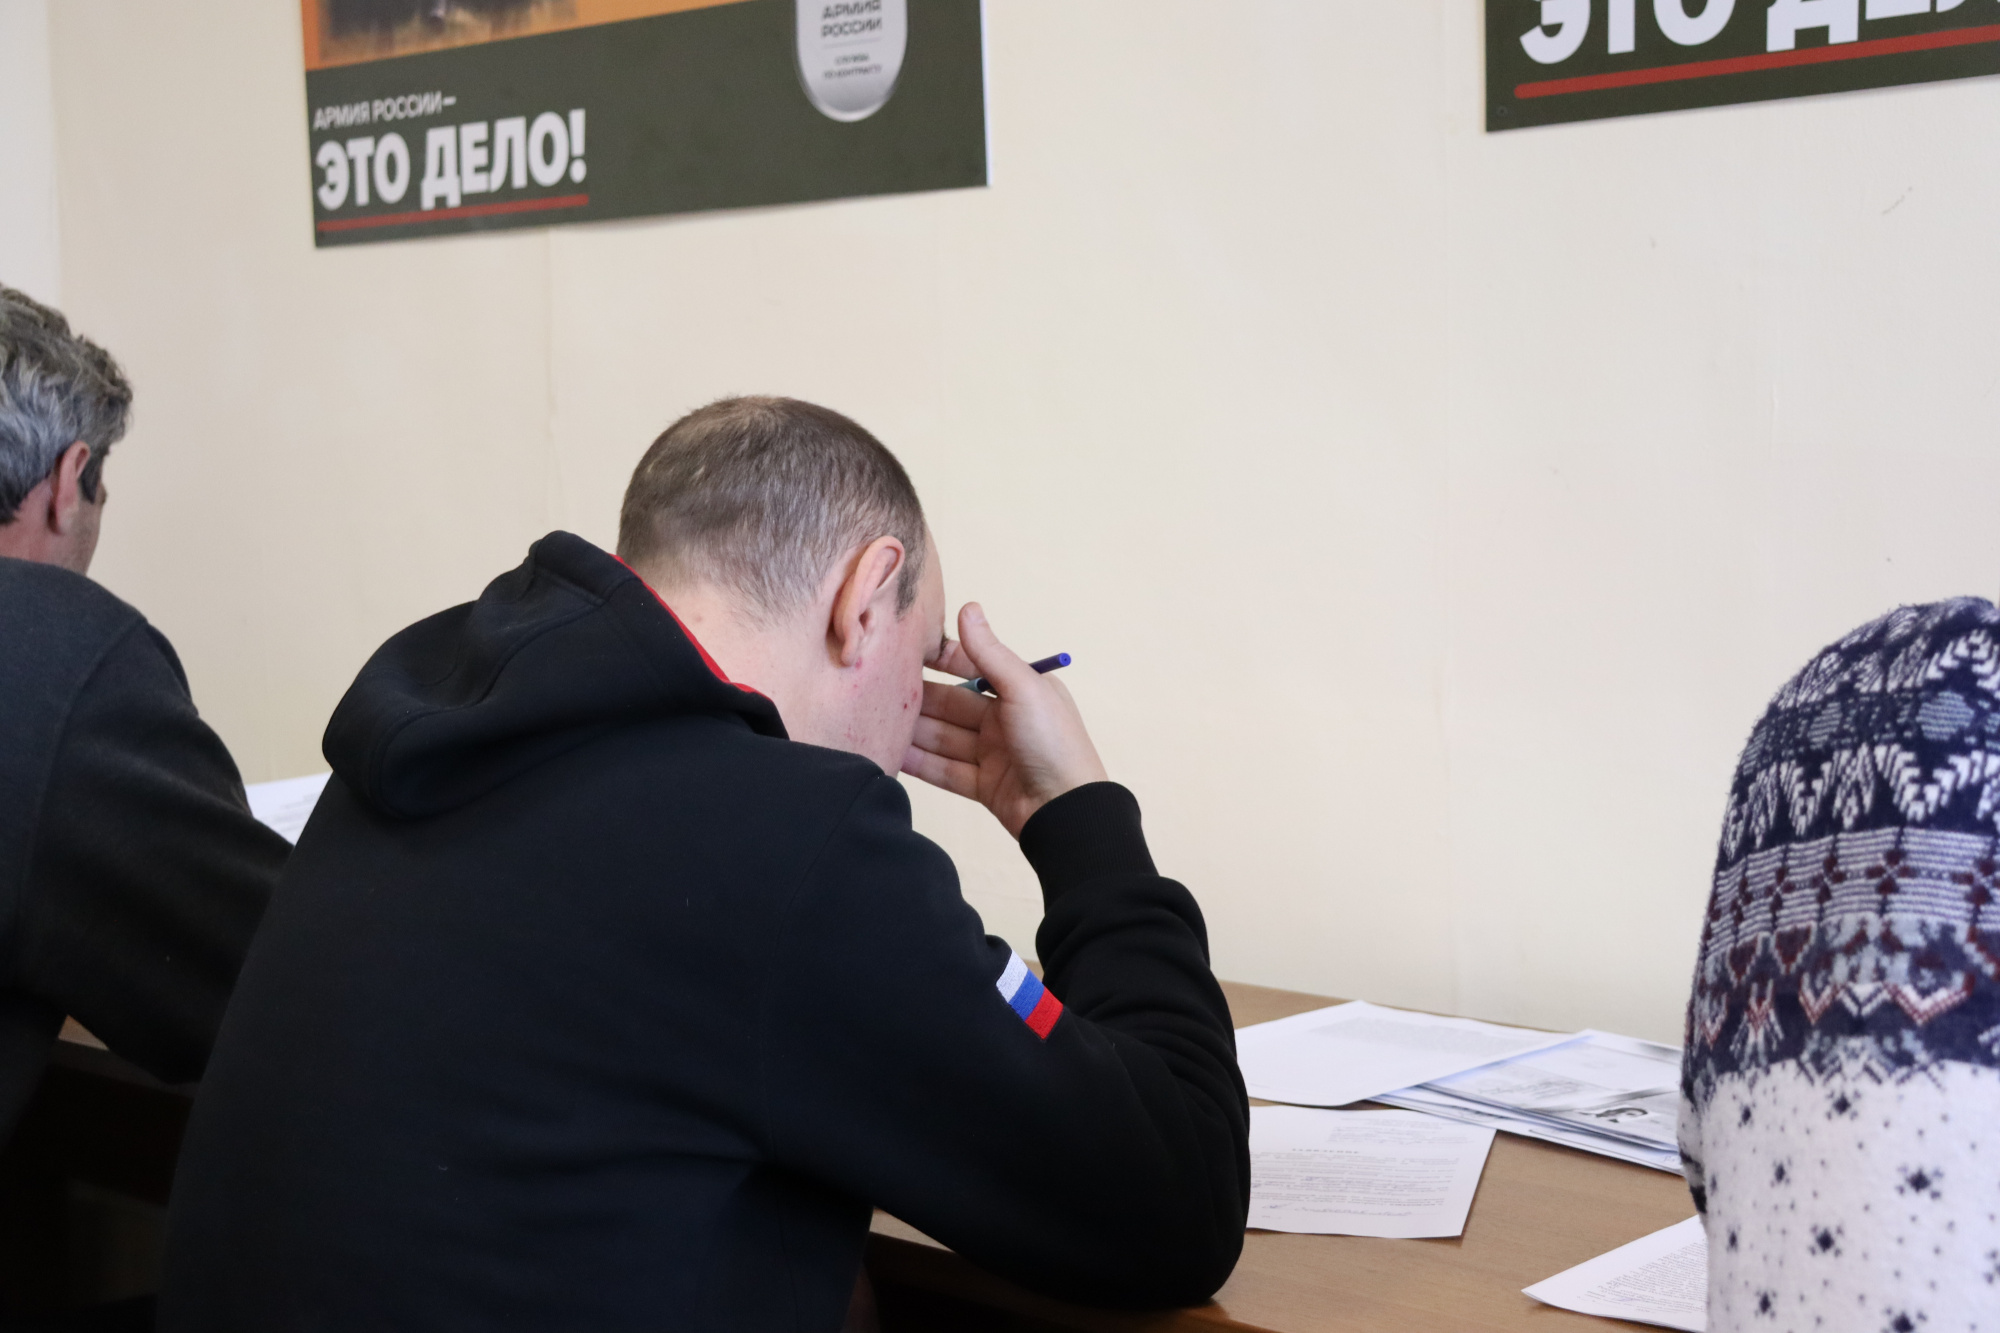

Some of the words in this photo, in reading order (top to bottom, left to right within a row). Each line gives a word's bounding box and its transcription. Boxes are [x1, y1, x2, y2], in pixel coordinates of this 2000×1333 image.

[823, 0, 882, 20] АРМИЯ
[822, 18, 882, 37] РОССИИ
[313, 101, 371, 131] АРМИЯ
[315, 132, 411, 211] ЭТО
[420, 108, 587, 211] ДЕЛО!
